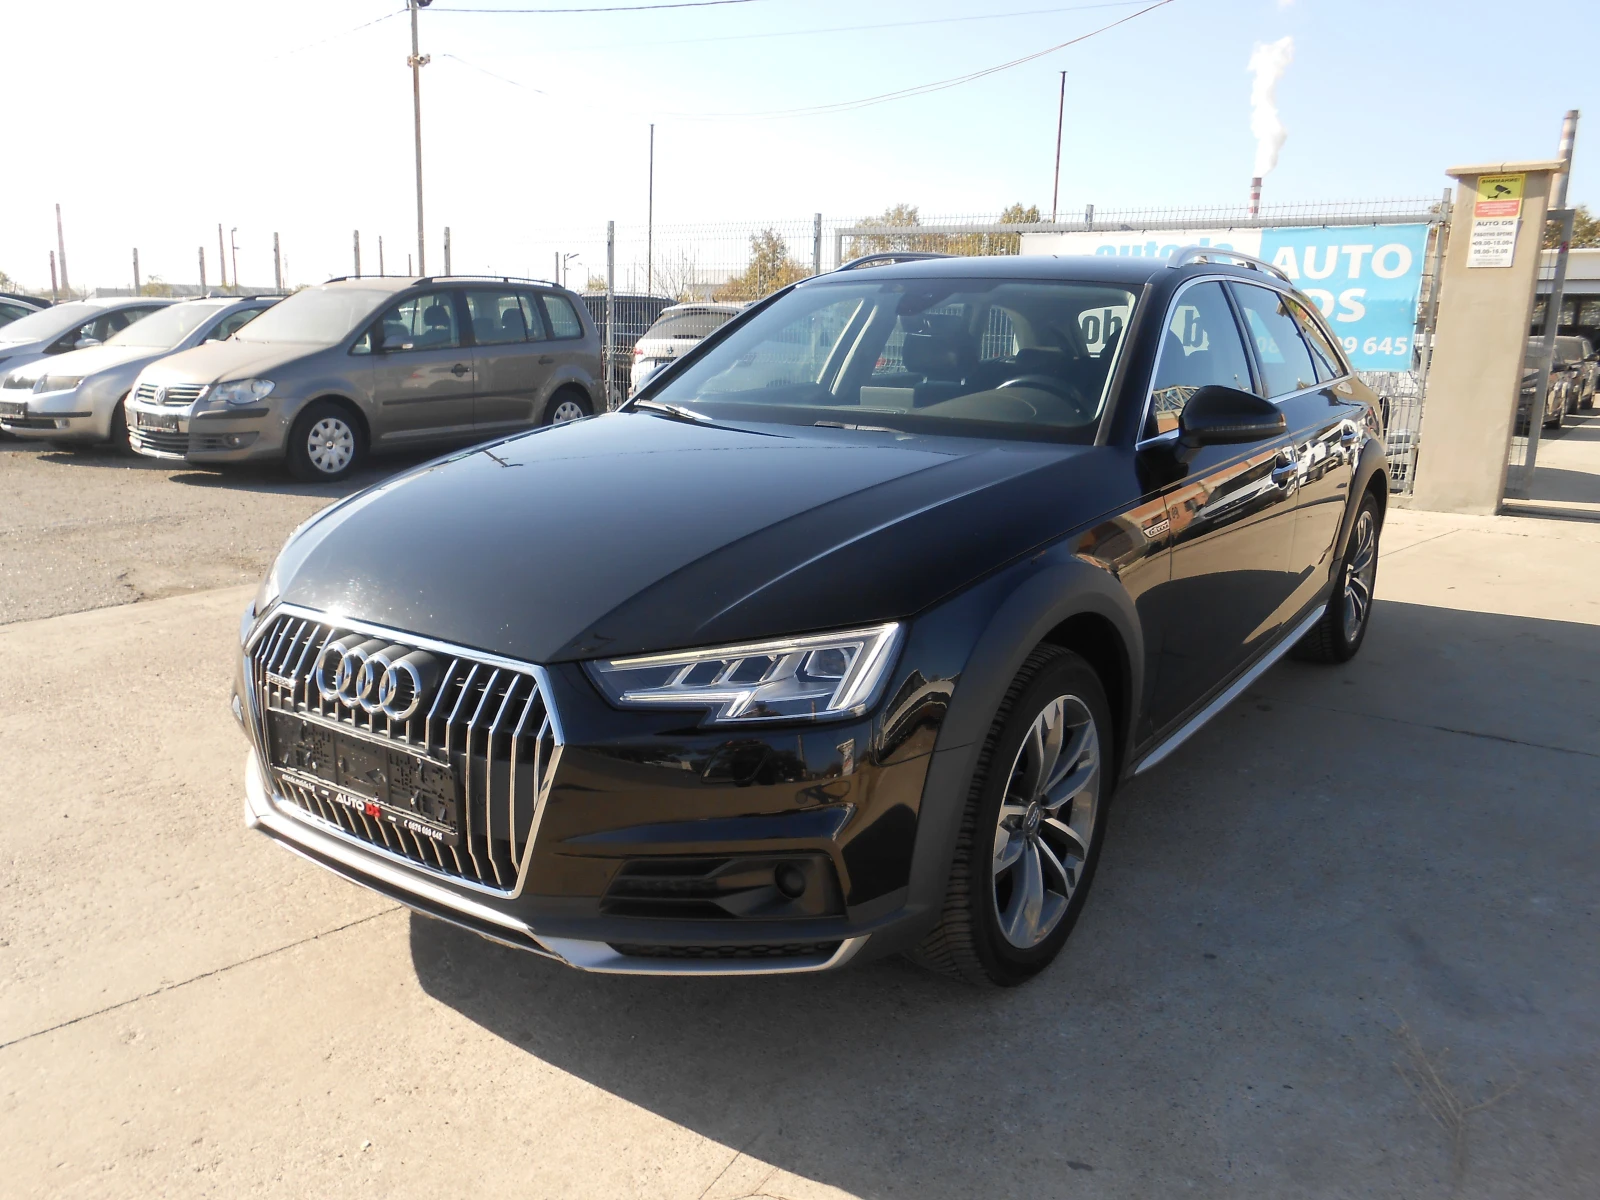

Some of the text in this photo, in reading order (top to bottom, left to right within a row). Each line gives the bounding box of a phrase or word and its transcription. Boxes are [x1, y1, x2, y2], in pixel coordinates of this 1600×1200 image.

[1267, 243, 1413, 280] AUTO
[1363, 336, 1408, 355] 645
[336, 793, 381, 818] AUTO DS
